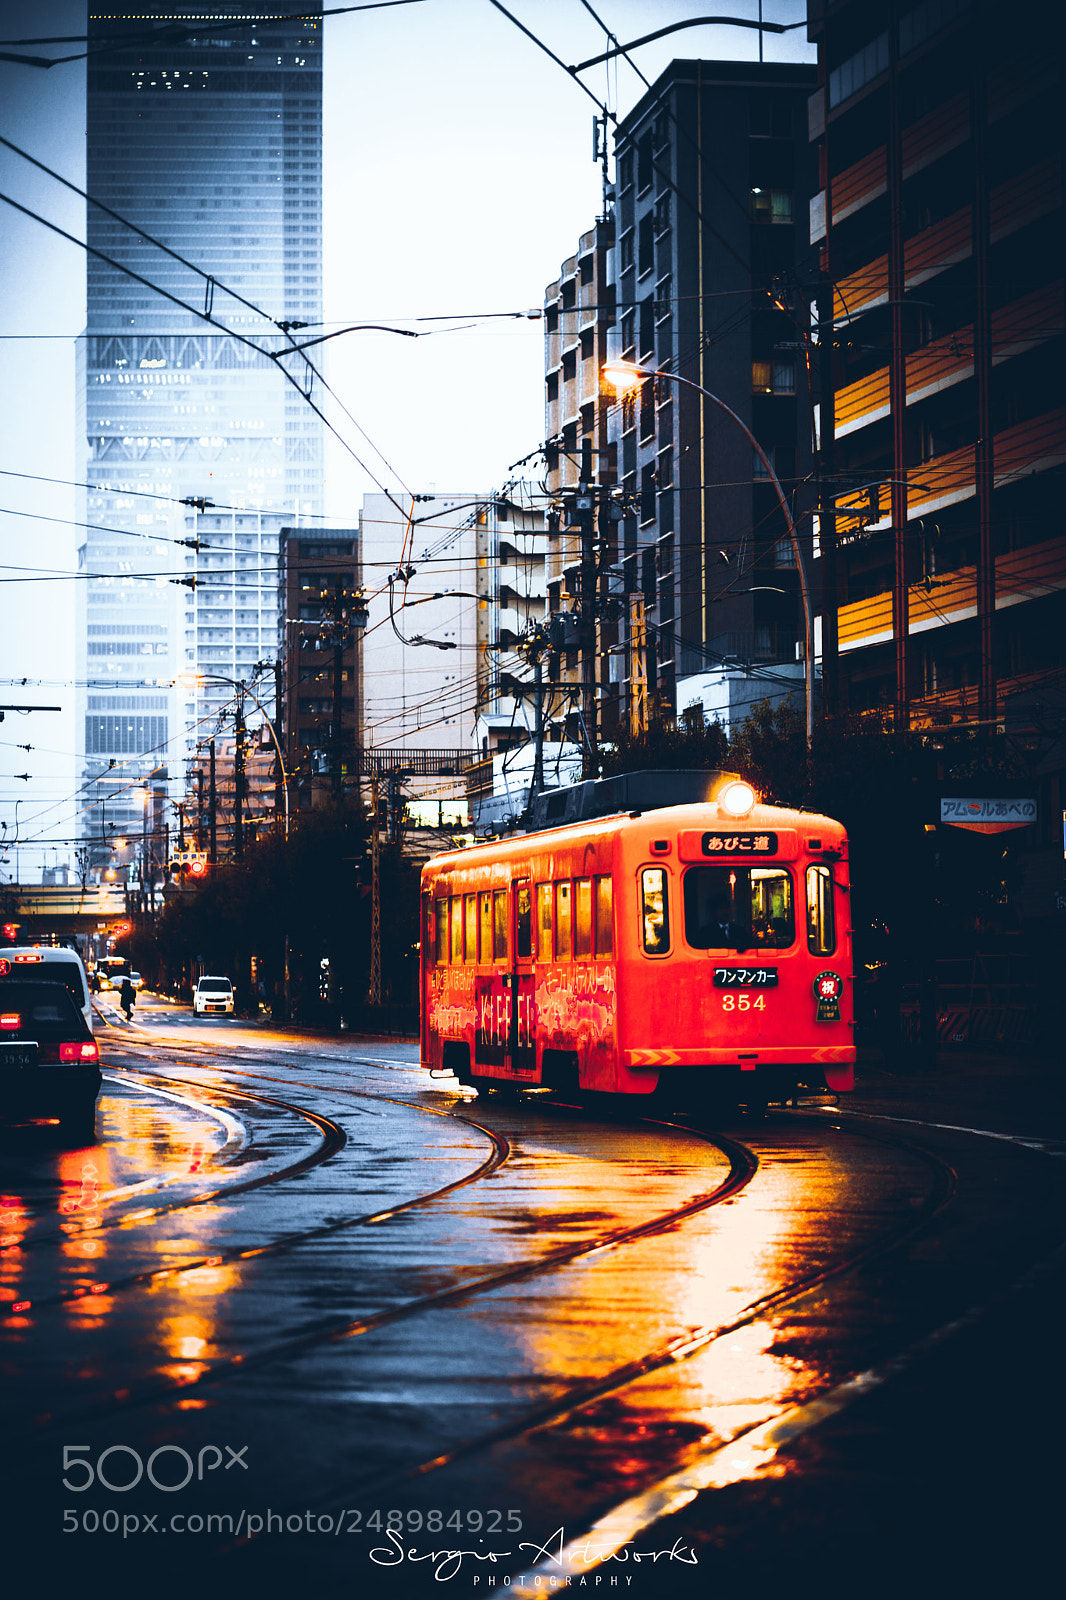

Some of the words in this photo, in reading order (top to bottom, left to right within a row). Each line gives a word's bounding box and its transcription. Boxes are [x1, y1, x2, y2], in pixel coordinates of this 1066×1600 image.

[708, 836, 770, 851] あびこ道
[715, 969, 776, 984] ワンマンカー
[821, 980, 835, 995] 祝
[722, 994, 767, 1011] 354
